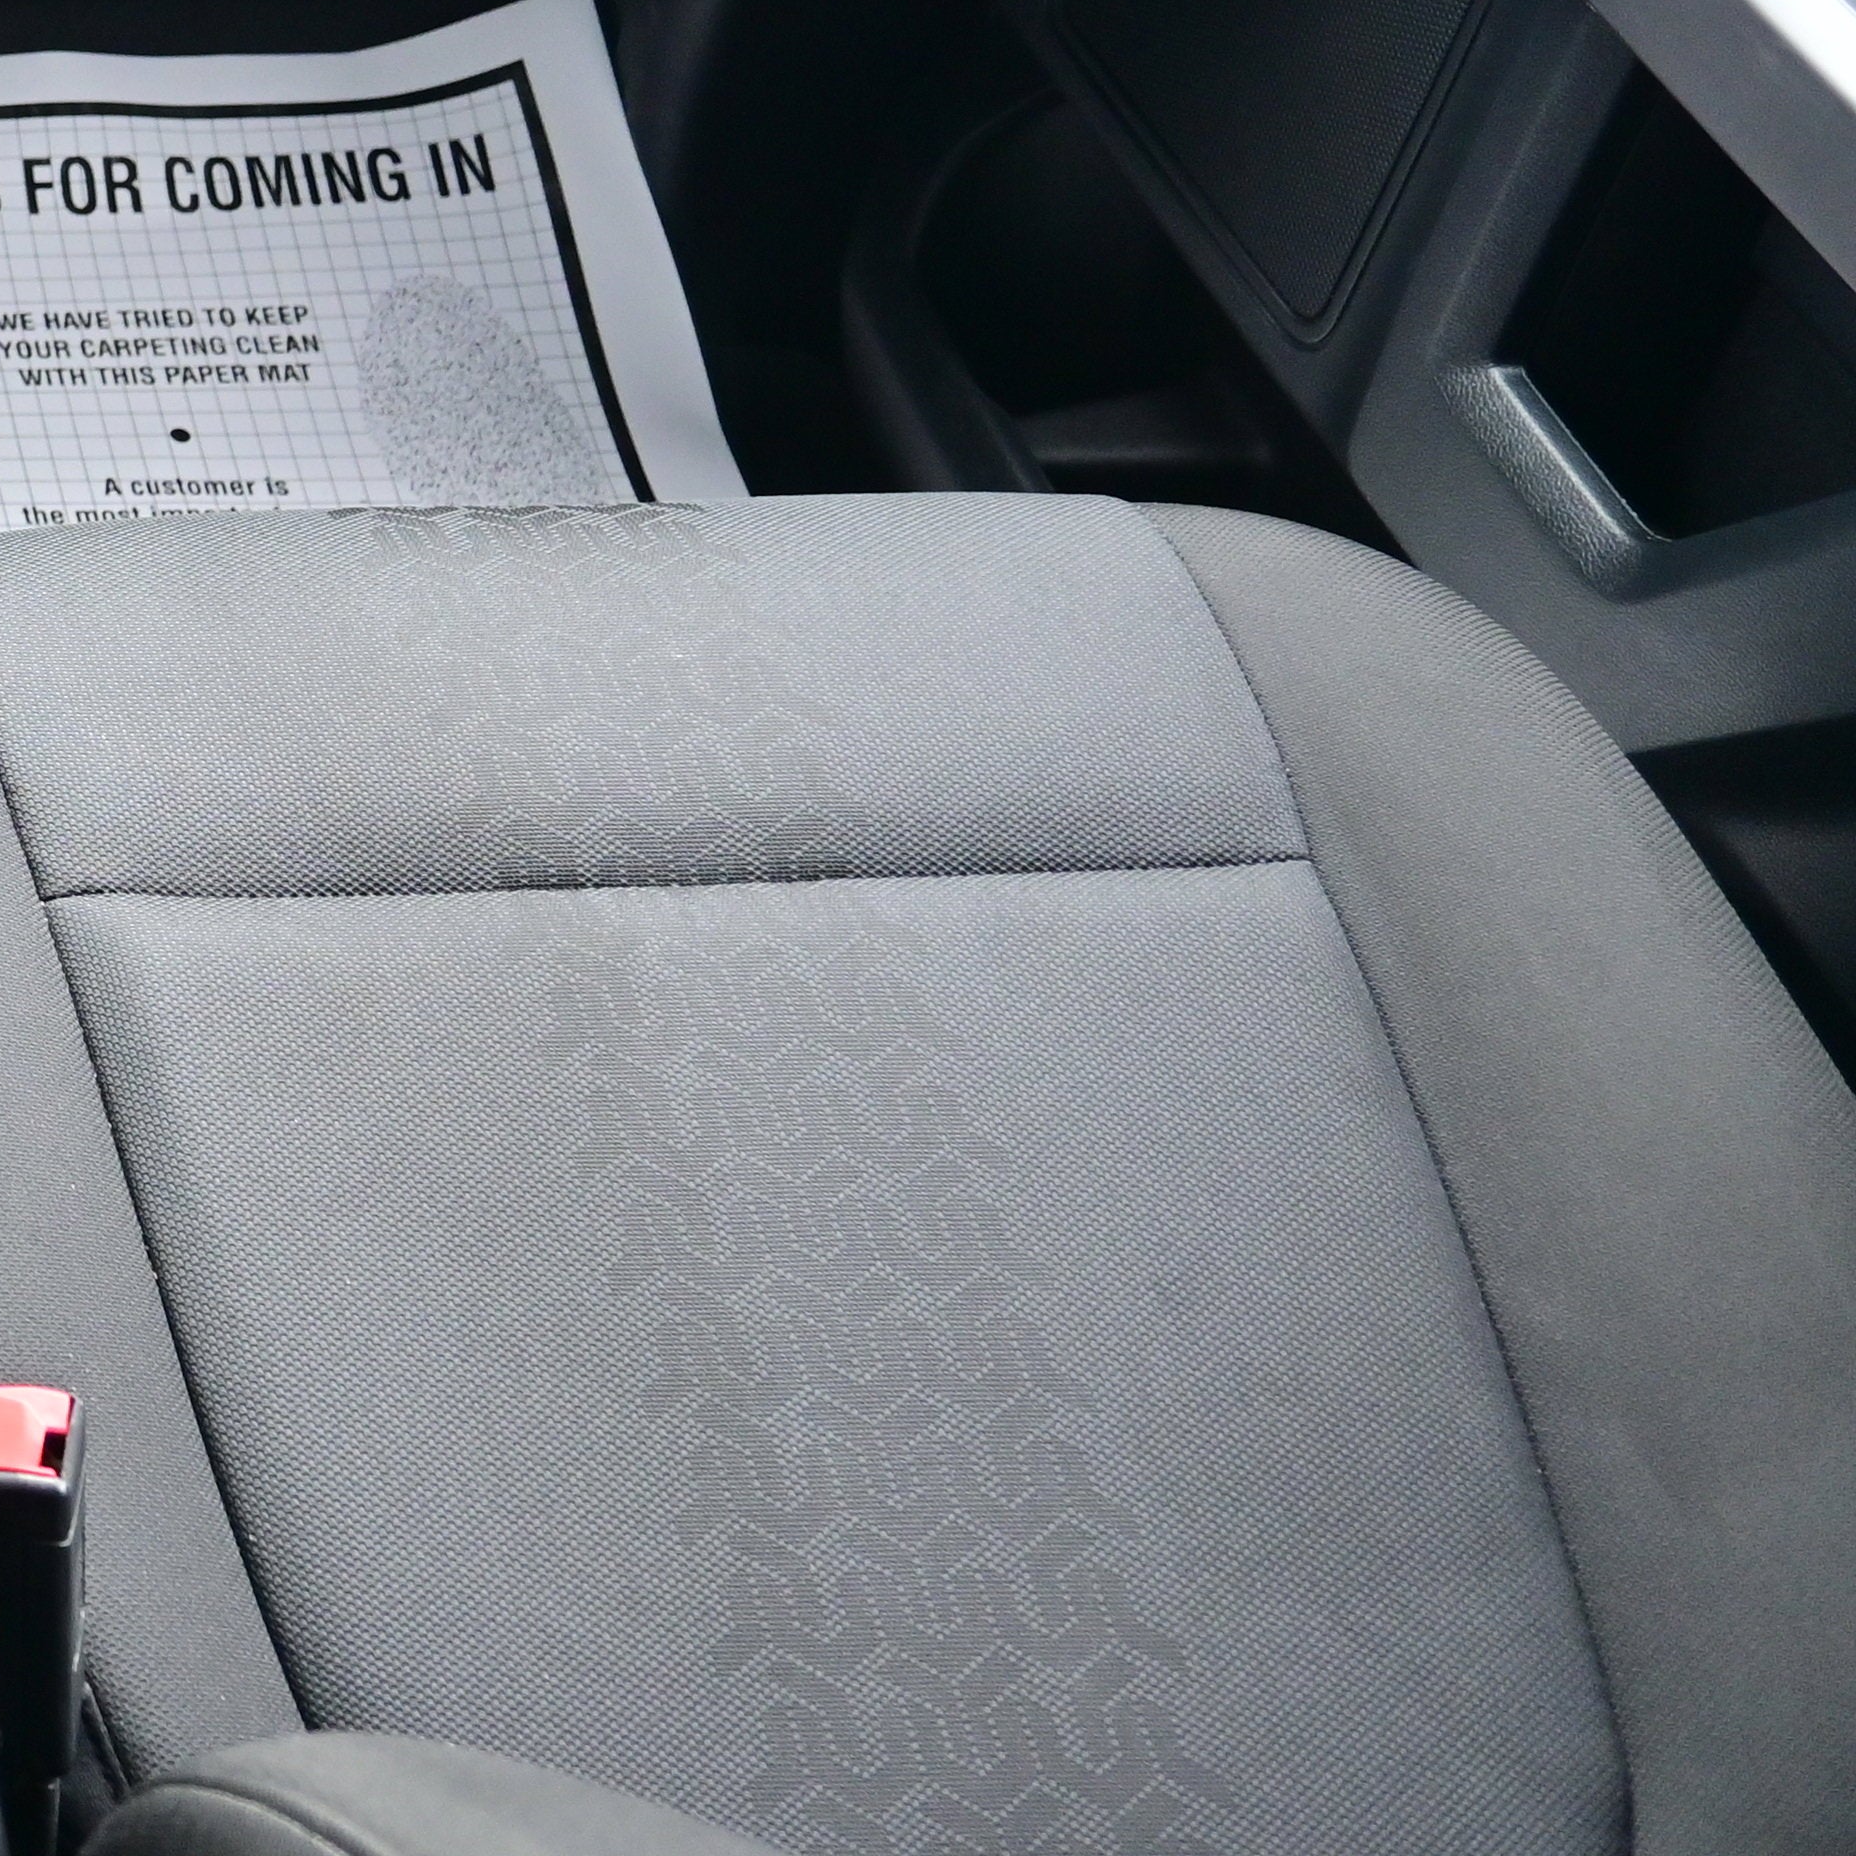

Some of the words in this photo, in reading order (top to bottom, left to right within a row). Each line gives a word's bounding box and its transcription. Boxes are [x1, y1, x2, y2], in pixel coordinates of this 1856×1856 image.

[24, 155, 143, 215] FOR
[165, 147, 409, 214] COMING
[431, 134, 498, 198] IN
[44, 310, 110, 330] HAVE
[118, 309, 194, 329] TRIED
[203, 307, 236, 327] TO
[246, 306, 309, 326] KEEP
[81, 336, 227, 358] CARPETING
[235, 334, 321, 355] CLEAN
[19, 367, 88, 387] WITH
[98, 366, 156, 385] THIS
[165, 364, 250, 385] PAPER
[258, 363, 312, 383] MAT
[104, 478, 122, 496] A
[131, 478, 255, 496] customer
[265, 476, 290, 496] is
[22, 506, 65, 525] the
[75, 507, 138, 522] most
